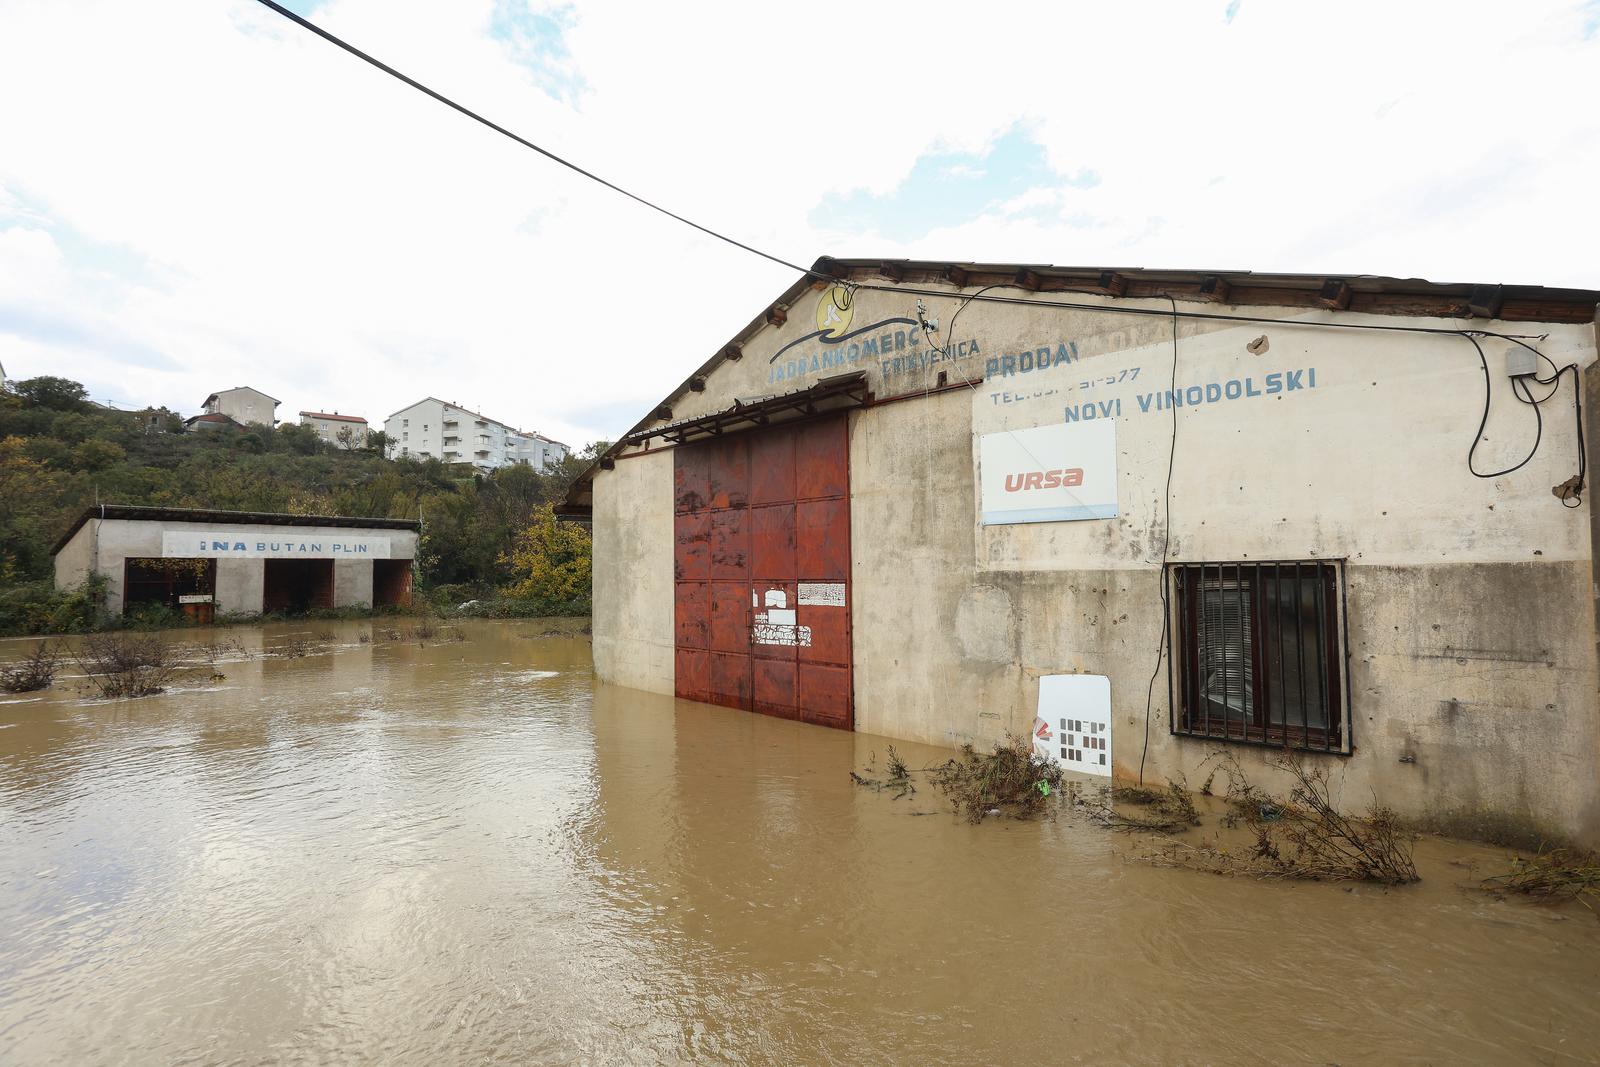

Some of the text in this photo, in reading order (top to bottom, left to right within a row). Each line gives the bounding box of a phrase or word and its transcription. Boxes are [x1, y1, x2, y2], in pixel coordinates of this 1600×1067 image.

[1064, 367, 1316, 424] NOVI VINODOLSKI
[256, 542, 322, 553] BUTAN
[333, 544, 368, 553] PLIN
